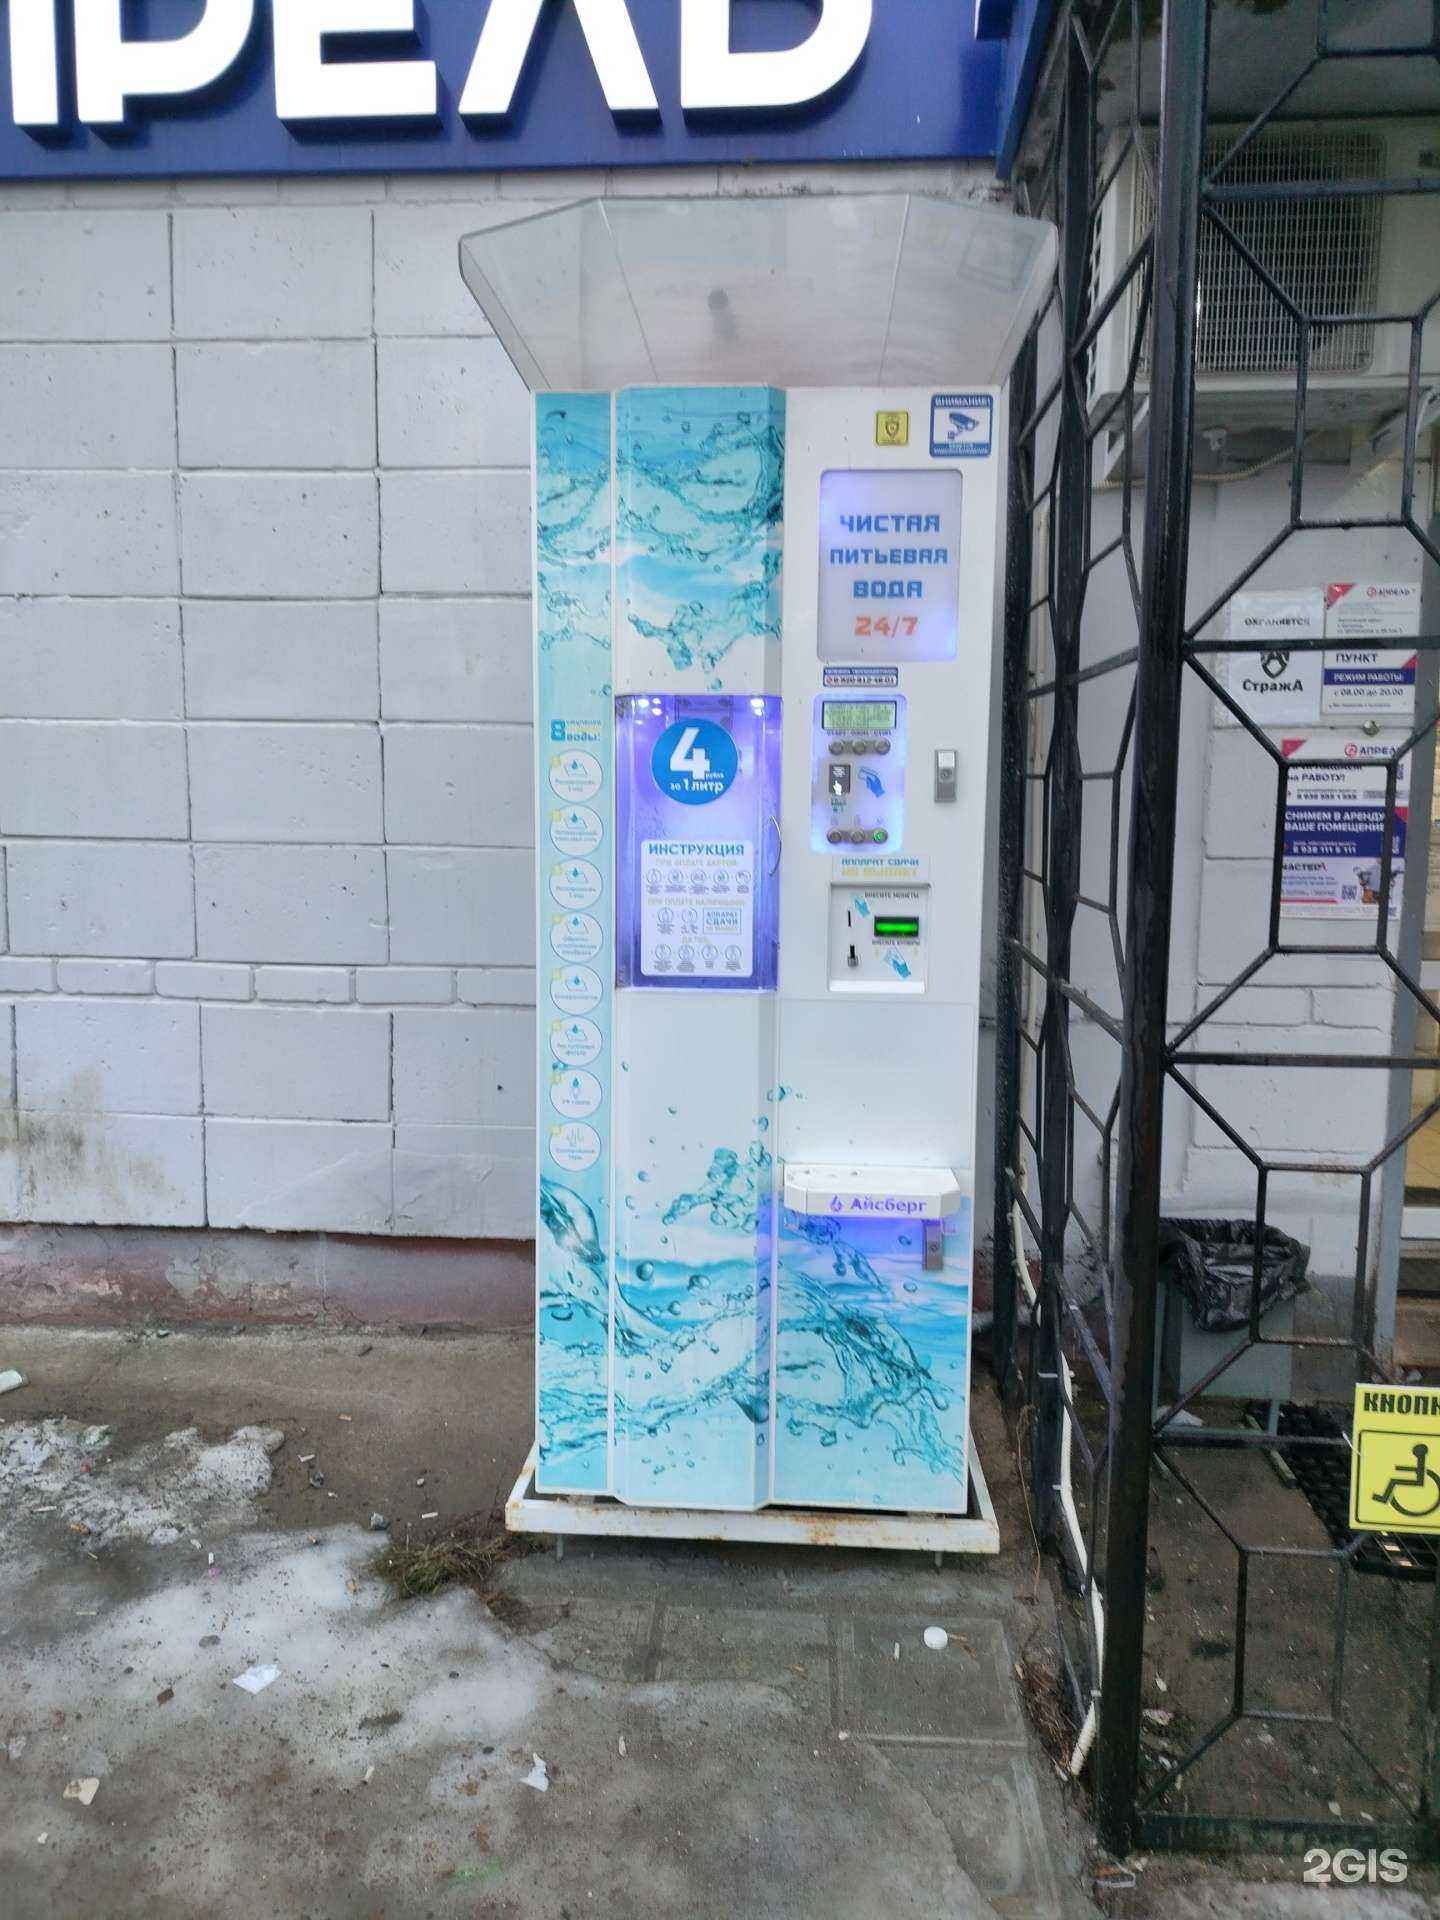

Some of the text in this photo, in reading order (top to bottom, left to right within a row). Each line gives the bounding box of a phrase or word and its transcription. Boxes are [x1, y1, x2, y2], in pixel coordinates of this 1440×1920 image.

[9, 0, 873, 125] РЕЛЬ
[840, 514, 940, 533] ЧИСТАЯ
[830, 548, 948, 565] ПИТЬЕВАЯ
[853, 580, 923, 599] ВОДА
[854, 616, 919, 637] 24/7
[1336, 653, 1378, 664] ПУНКТ
[669, 727, 710, 780] 4
[691, 780, 724, 795] литр
[1285, 811, 1331, 821] СНИМЕМ
[1333, 812, 1341, 821] В
[1284, 822, 1317, 831] ВАШЕ
[648, 843, 745, 857] ИНСТРУКЦИЯ
[850, 1196, 928, 1214] Айсберг
